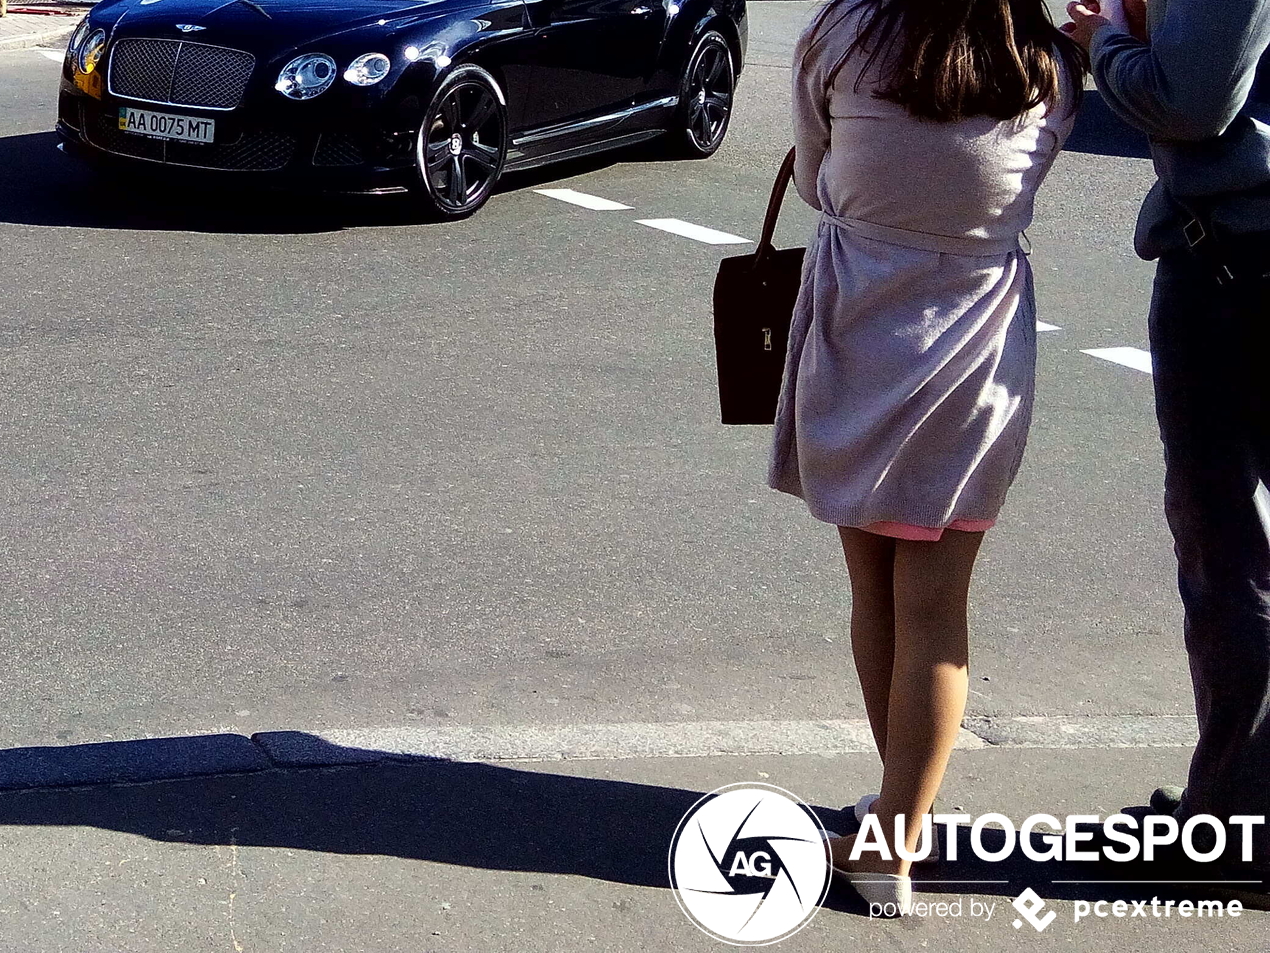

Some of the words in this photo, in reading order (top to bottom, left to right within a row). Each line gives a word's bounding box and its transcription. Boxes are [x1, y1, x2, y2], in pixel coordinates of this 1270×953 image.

[127, 111, 147, 131] AA
[150, 115, 185, 136] 0075
[188, 119, 212, 140] MT
